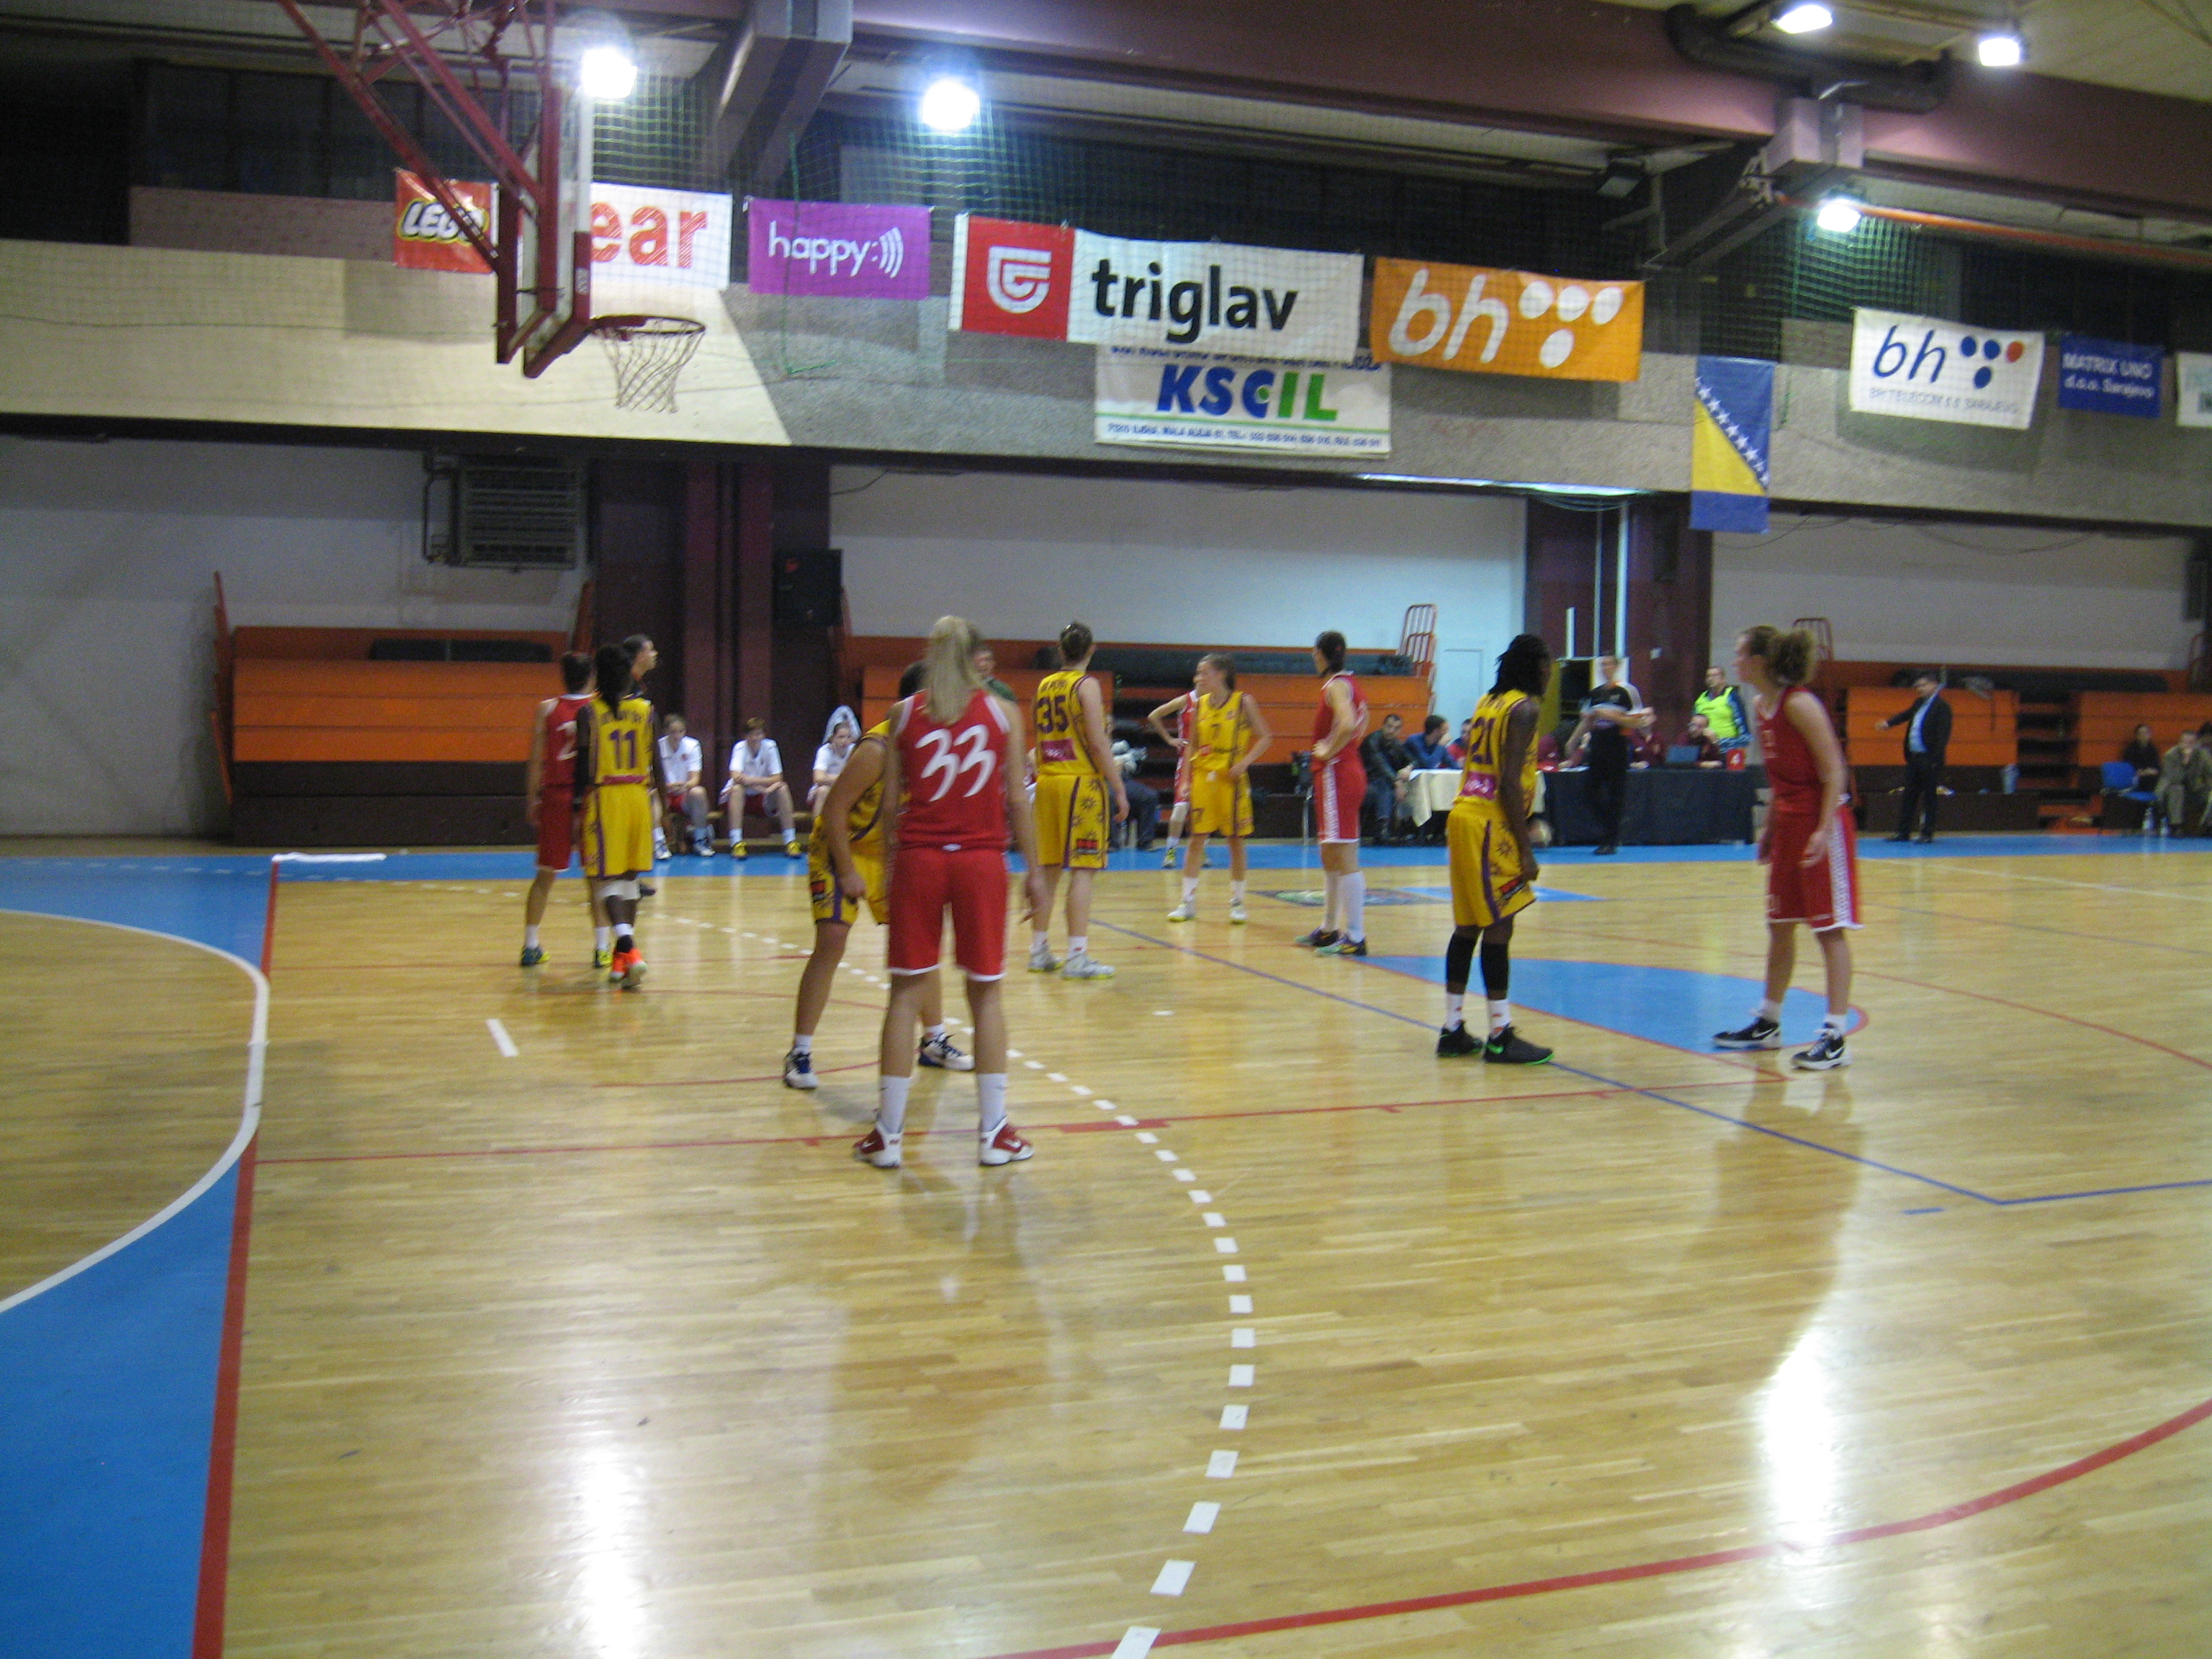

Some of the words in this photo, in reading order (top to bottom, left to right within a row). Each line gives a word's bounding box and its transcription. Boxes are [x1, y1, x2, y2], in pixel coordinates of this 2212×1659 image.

[1092, 258, 1298, 343] triglav
[1388, 268, 1509, 364] bh
[1873, 325, 1946, 384] bh
[1035, 696, 1069, 733] 35
[1471, 716, 1496, 765] 21
[610, 729, 637, 769] 11
[914, 724, 997, 802] 33
